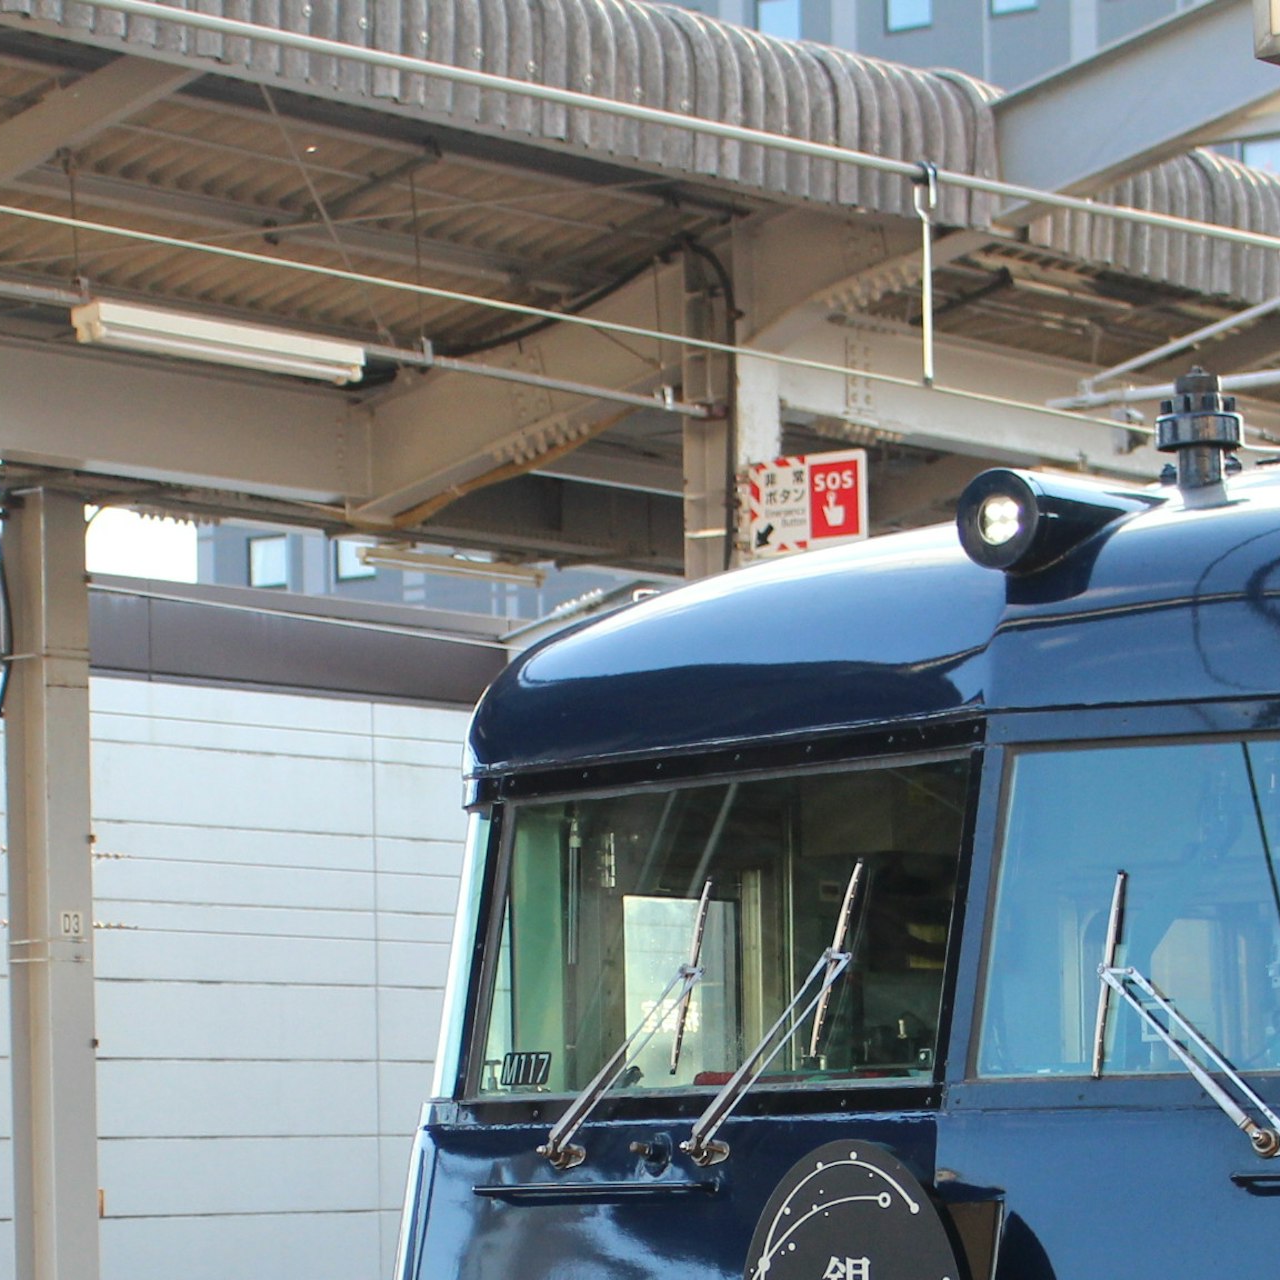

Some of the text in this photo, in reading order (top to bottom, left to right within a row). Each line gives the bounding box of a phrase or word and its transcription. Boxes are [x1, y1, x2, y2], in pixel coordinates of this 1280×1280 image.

[813, 470, 855, 492] SOS
[765, 488, 806, 505] ボタン
[63, 913, 80, 934] D3
[502, 1054, 549, 1084] M117
